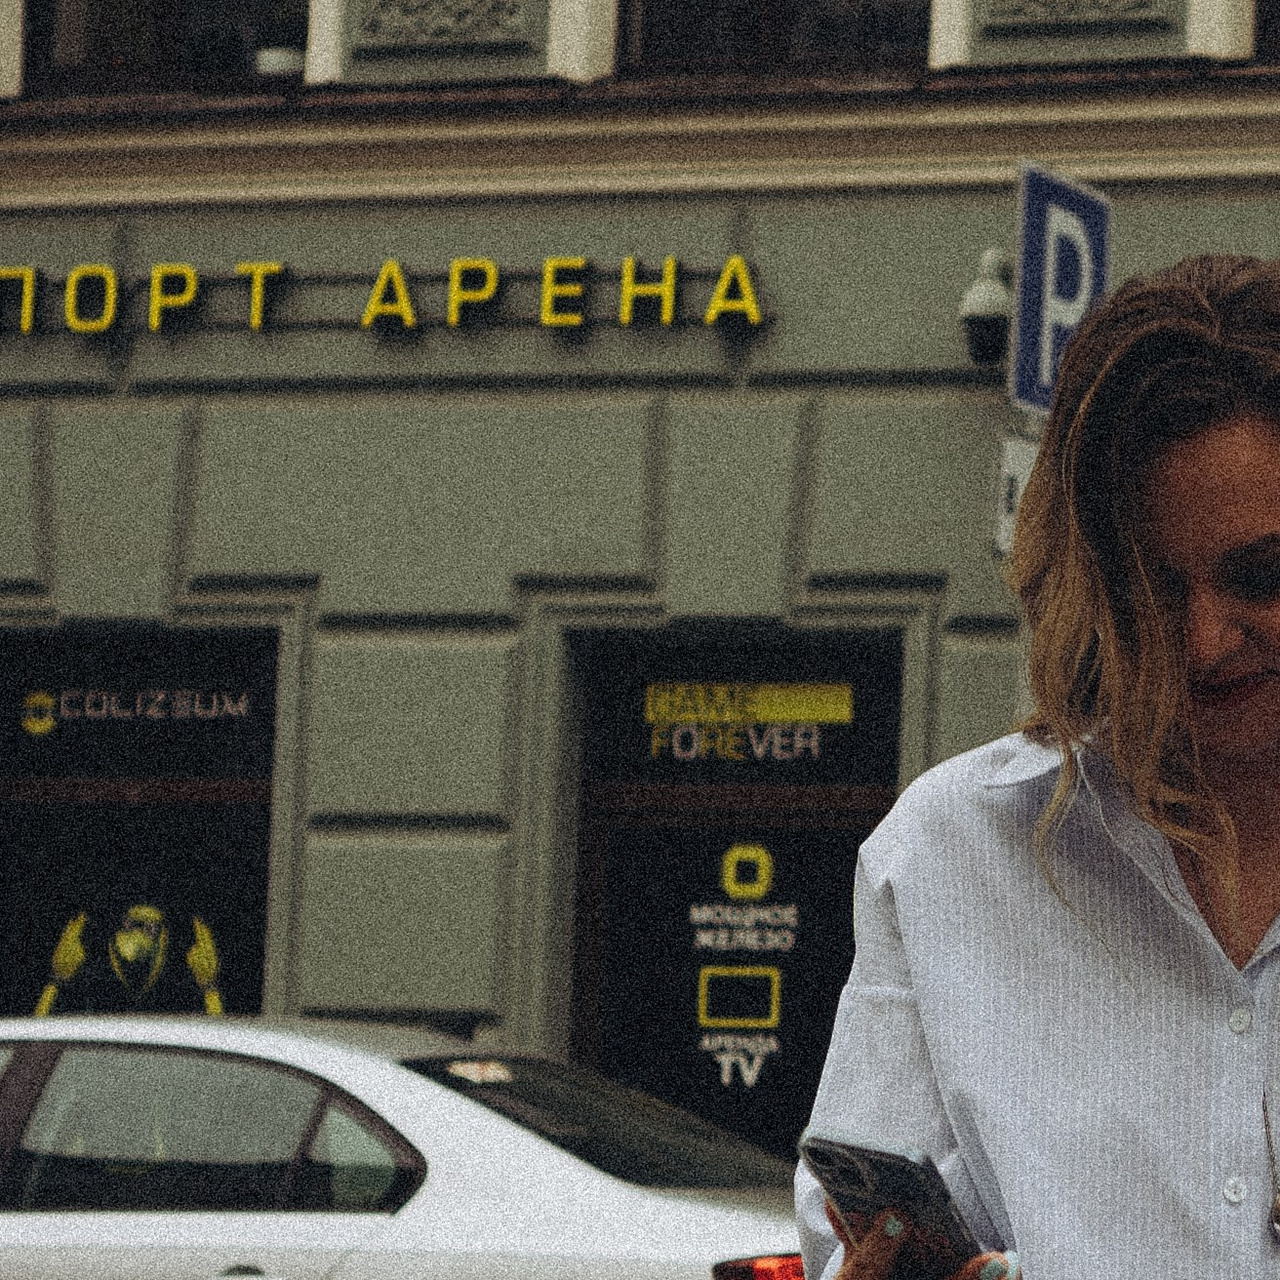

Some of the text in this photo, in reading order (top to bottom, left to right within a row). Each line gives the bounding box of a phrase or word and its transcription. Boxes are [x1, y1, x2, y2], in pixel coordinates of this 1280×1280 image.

[361, 255, 762, 328] АРЕНА
[1039, 202, 1094, 387] P
[59, 689, 249, 719] COLIZEUM
[651, 723, 819, 759] FOREVER
[715, 1053, 763, 1087] TV
